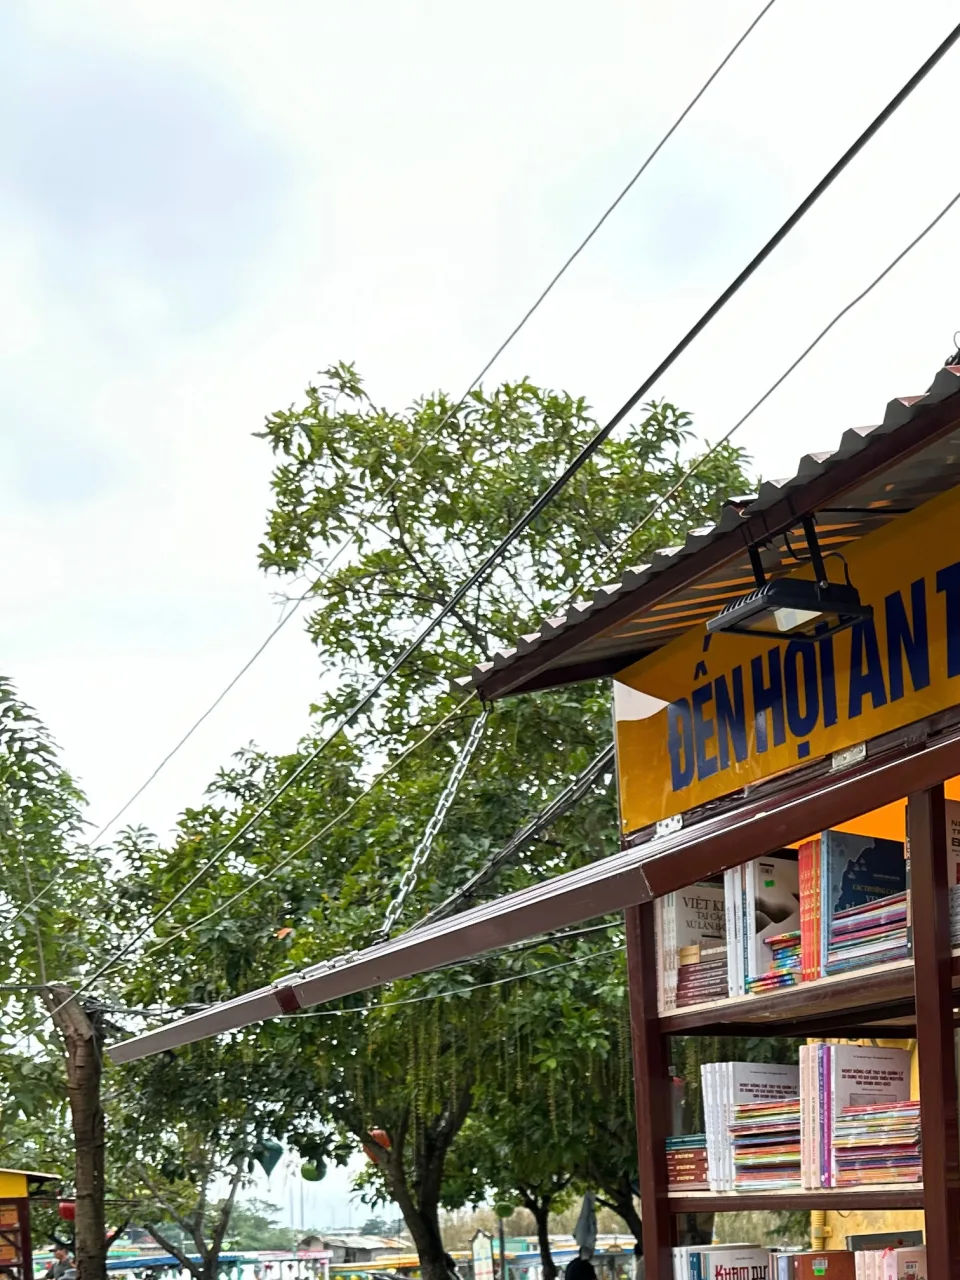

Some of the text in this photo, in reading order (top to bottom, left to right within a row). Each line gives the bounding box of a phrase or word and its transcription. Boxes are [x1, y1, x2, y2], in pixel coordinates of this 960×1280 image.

[667, 634, 748, 792] ĐẾN
[848, 577, 931, 719] AN
[682, 896, 725, 911] VIỆT KI
